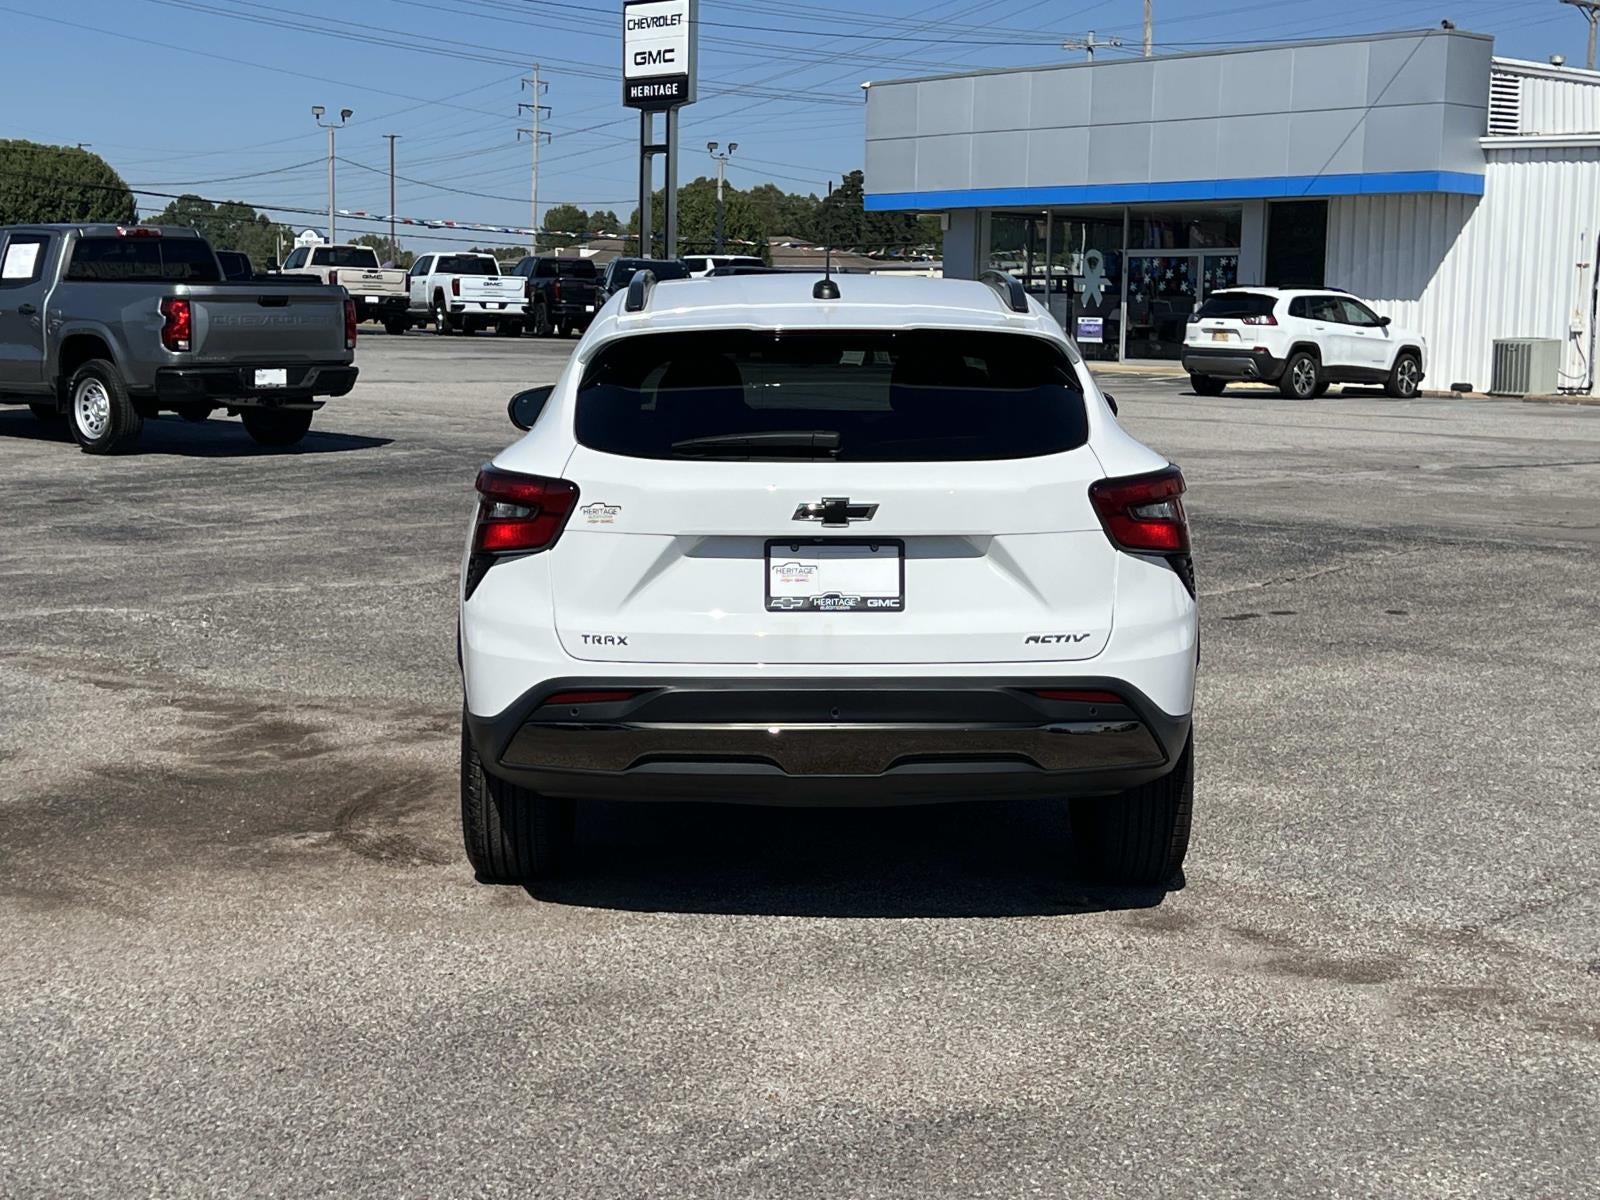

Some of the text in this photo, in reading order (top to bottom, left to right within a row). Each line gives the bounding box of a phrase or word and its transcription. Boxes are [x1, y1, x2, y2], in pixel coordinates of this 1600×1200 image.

[627, 13, 683, 31] CHEVROLET
[634, 48, 675, 66] GMC
[630, 83, 679, 98] HERITAGE
[776, 567, 814, 575] HERITAGE
[813, 598, 857, 606] HERITAGE
[867, 599, 900, 607] GMC
[581, 634, 629, 646] TRAX
[1024, 633, 1090, 644] ACTIV
